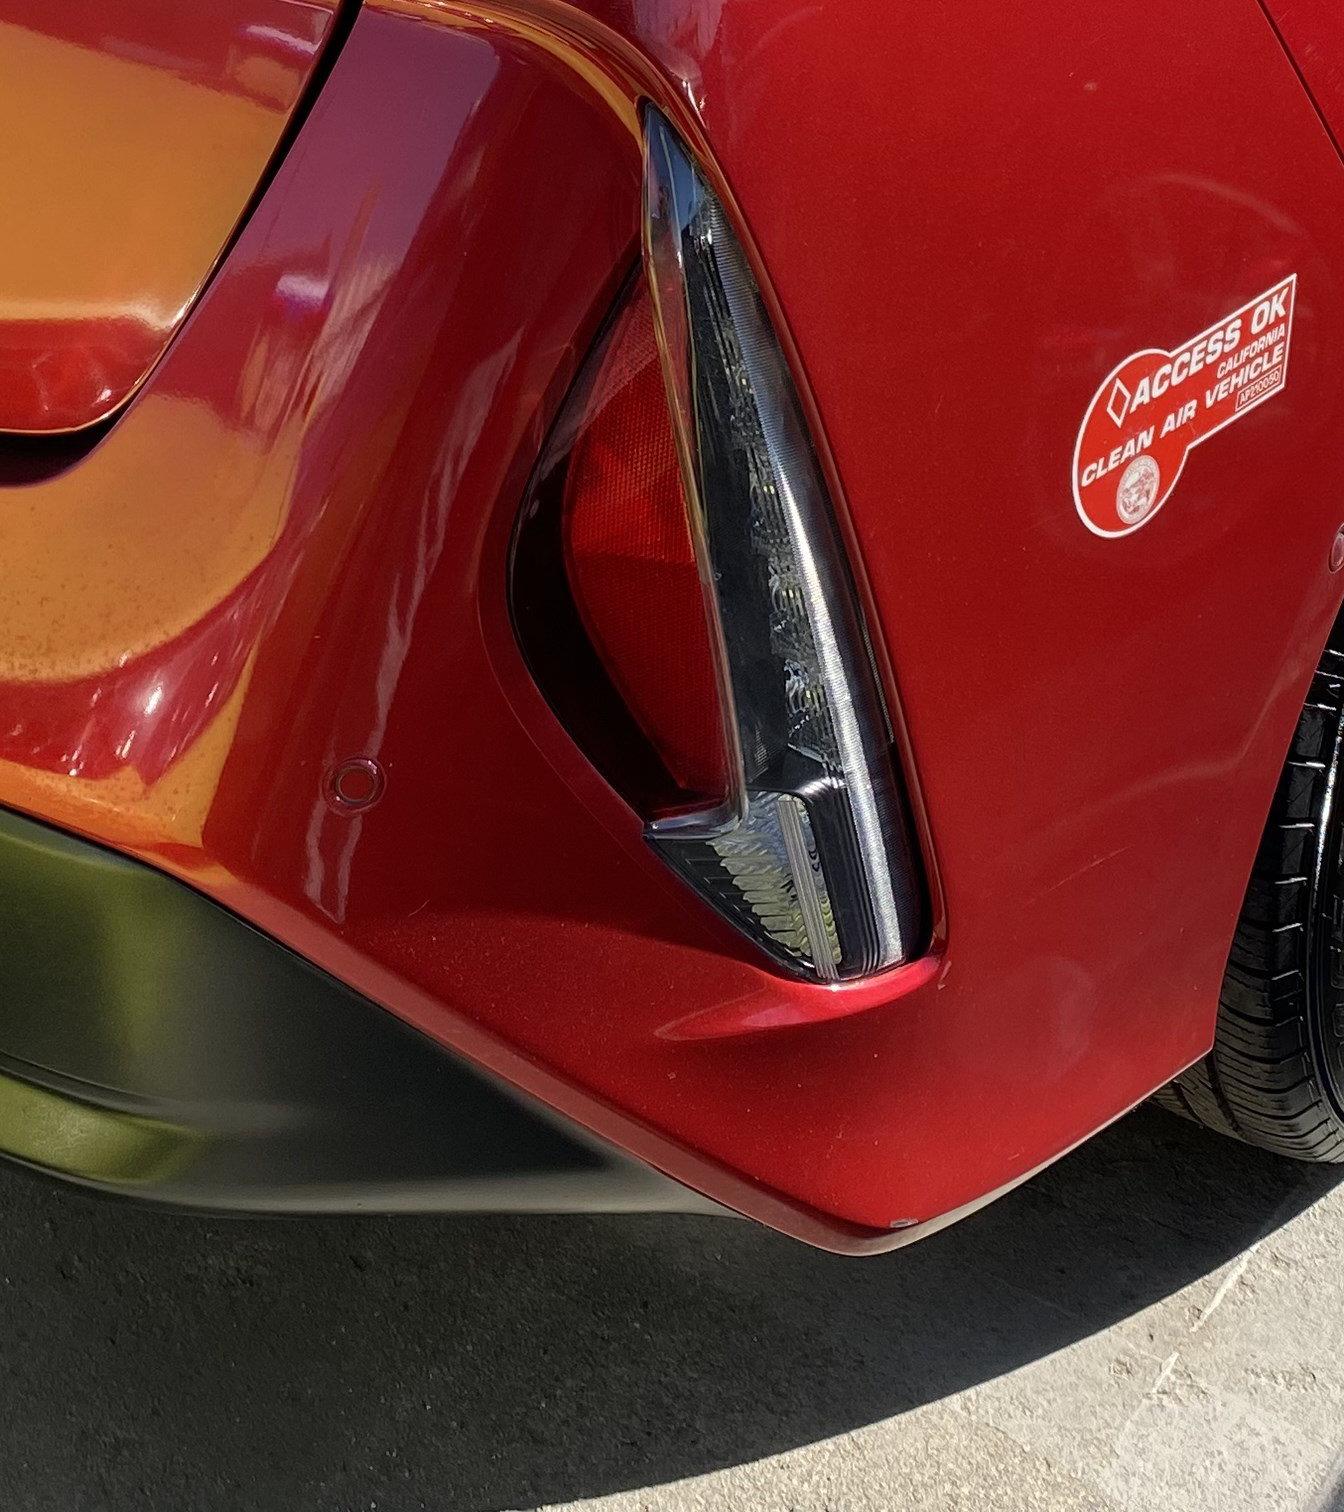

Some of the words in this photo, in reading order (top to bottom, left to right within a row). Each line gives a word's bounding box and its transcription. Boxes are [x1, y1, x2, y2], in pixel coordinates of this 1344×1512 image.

[1129, 318, 1242, 414] ACCESS
[1250, 286, 1289, 335] OK
[1217, 323, 1286, 379] CALIFORNIA
[1081, 425, 1155, 487] CLEAN
[1160, 399, 1197, 438] AIR
[1206, 342, 1284, 408] VEHICLE
